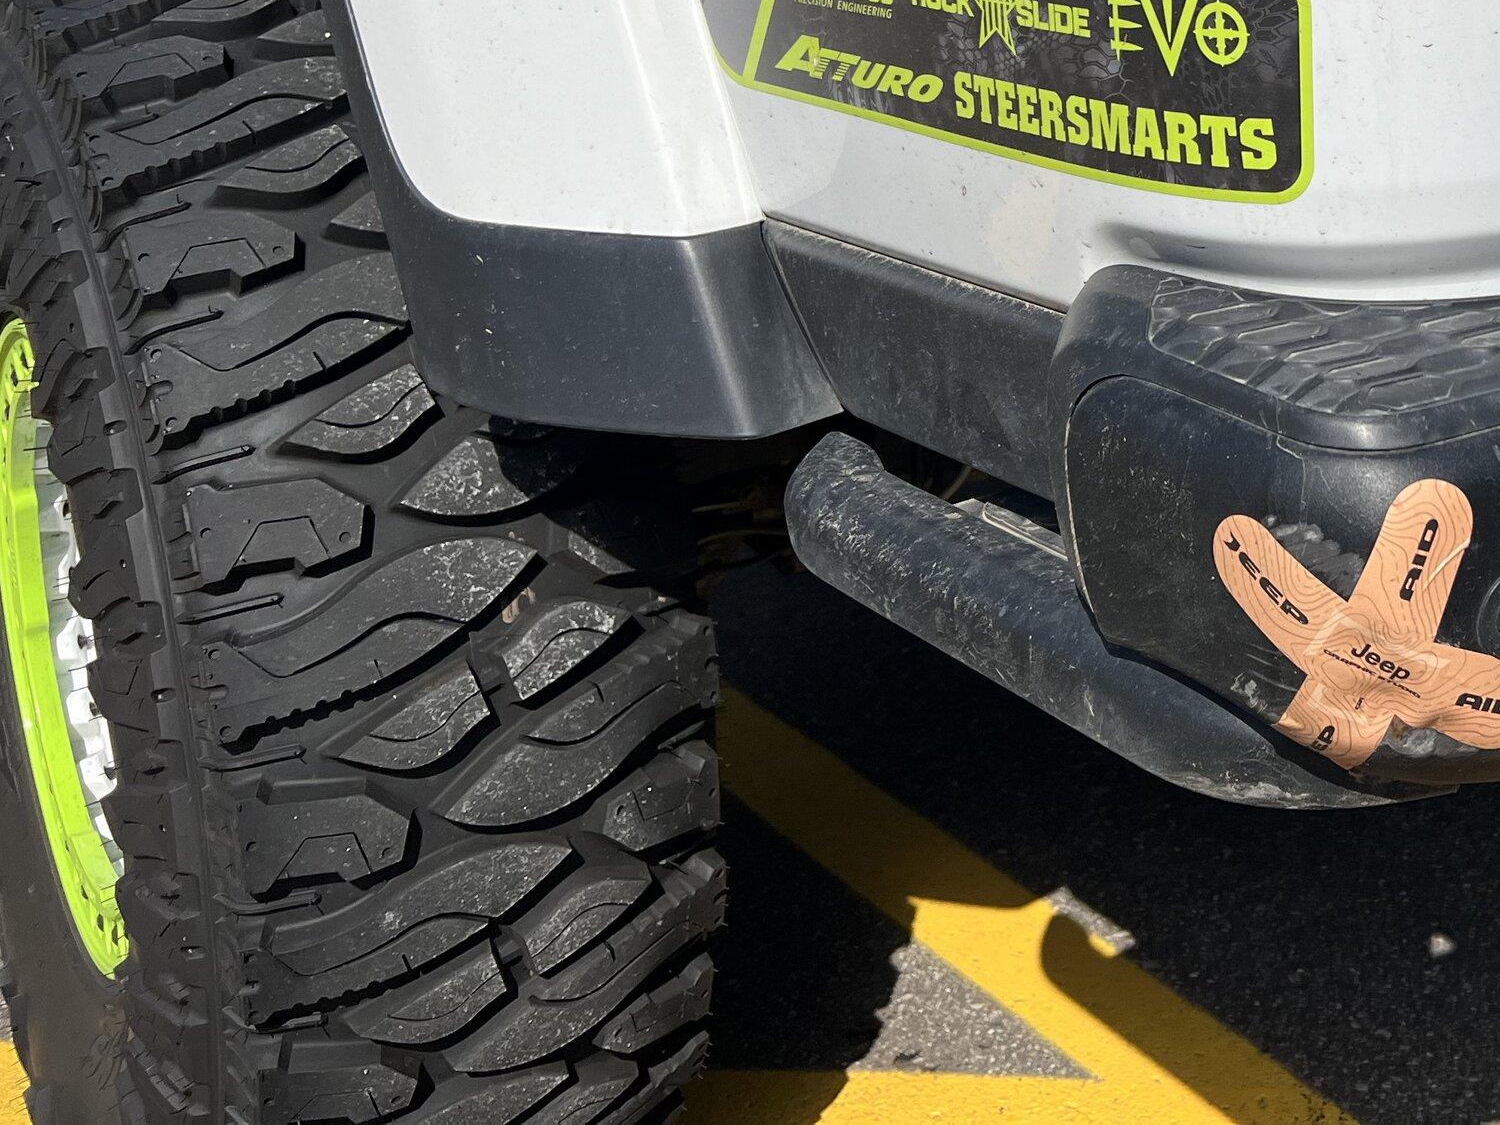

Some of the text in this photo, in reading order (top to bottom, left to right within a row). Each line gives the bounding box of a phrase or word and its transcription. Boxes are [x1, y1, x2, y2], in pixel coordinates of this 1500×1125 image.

[837, 0, 892, 19] ENGINEERING
[1016, 0, 1091, 38] SLIDE
[774, 35, 943, 103] ATTURO
[954, 71, 1278, 170] STEERSMARTS
[1222, 530, 1309, 625] JEEP
[1399, 518, 1439, 602] AID
[1323, 649, 1421, 698] GRAPHIC STUDIO
[1351, 643, 1411, 681] Jeep
